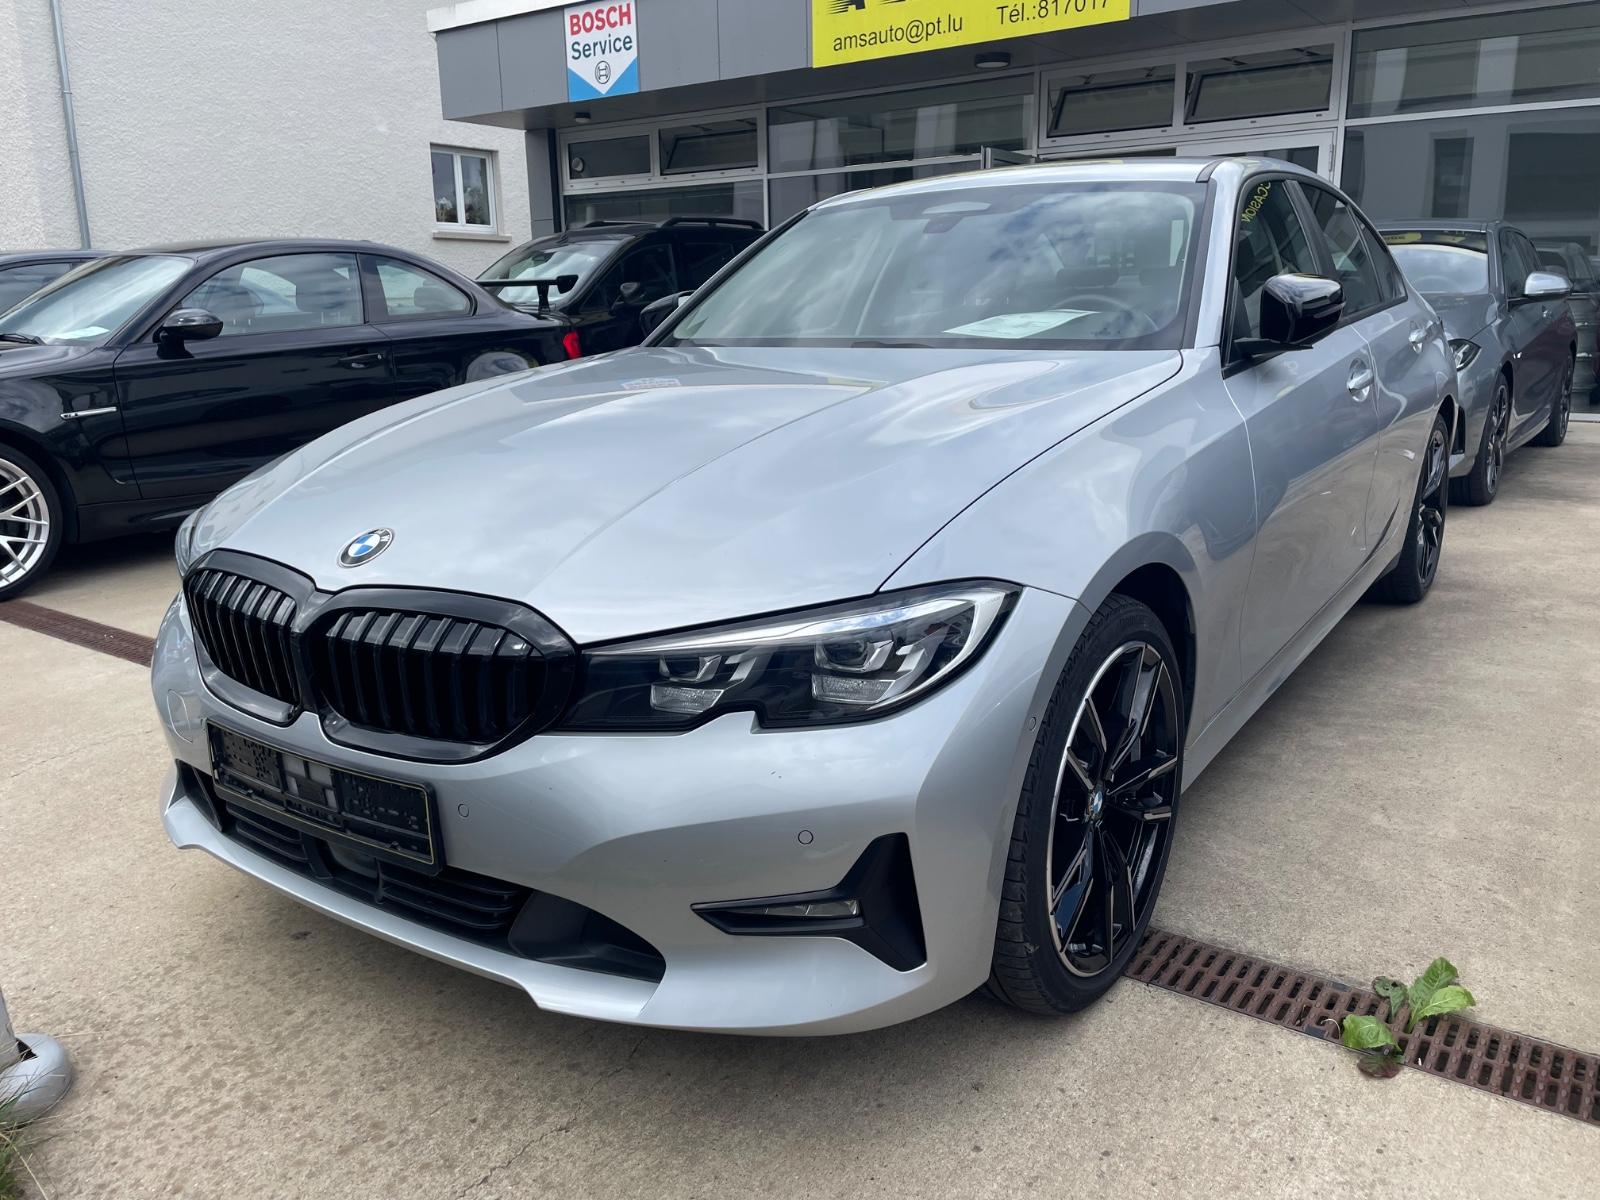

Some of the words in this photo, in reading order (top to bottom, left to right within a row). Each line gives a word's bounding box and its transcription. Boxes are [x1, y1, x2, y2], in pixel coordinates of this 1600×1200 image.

[569, 2, 632, 36] BOSCH
[833, 13, 963, 51] amsauto@pt.lu
[571, 33, 633, 60] Service
